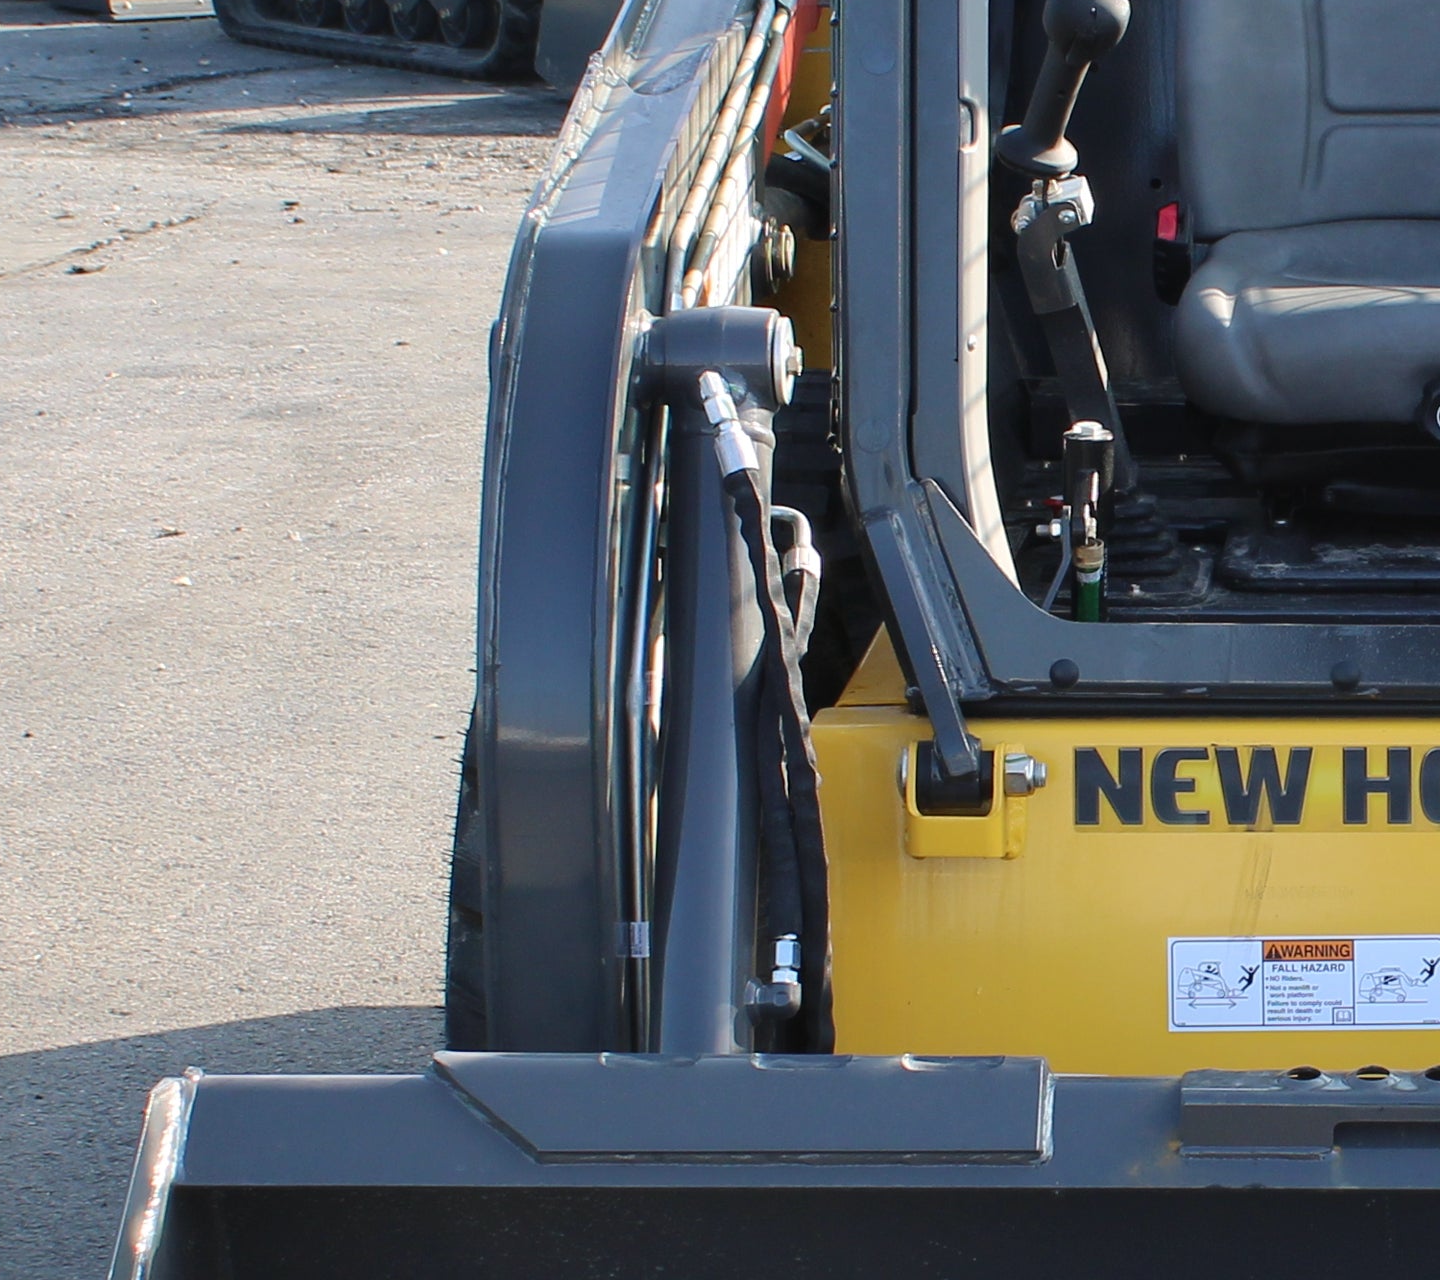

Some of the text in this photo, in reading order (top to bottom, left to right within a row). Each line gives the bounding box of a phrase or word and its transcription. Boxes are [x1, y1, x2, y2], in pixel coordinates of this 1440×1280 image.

[1073, 746, 1314, 826] NEW
[1280, 944, 1350, 958] WARNING
[1272, 963, 1346, 973] FALL HAZARD
